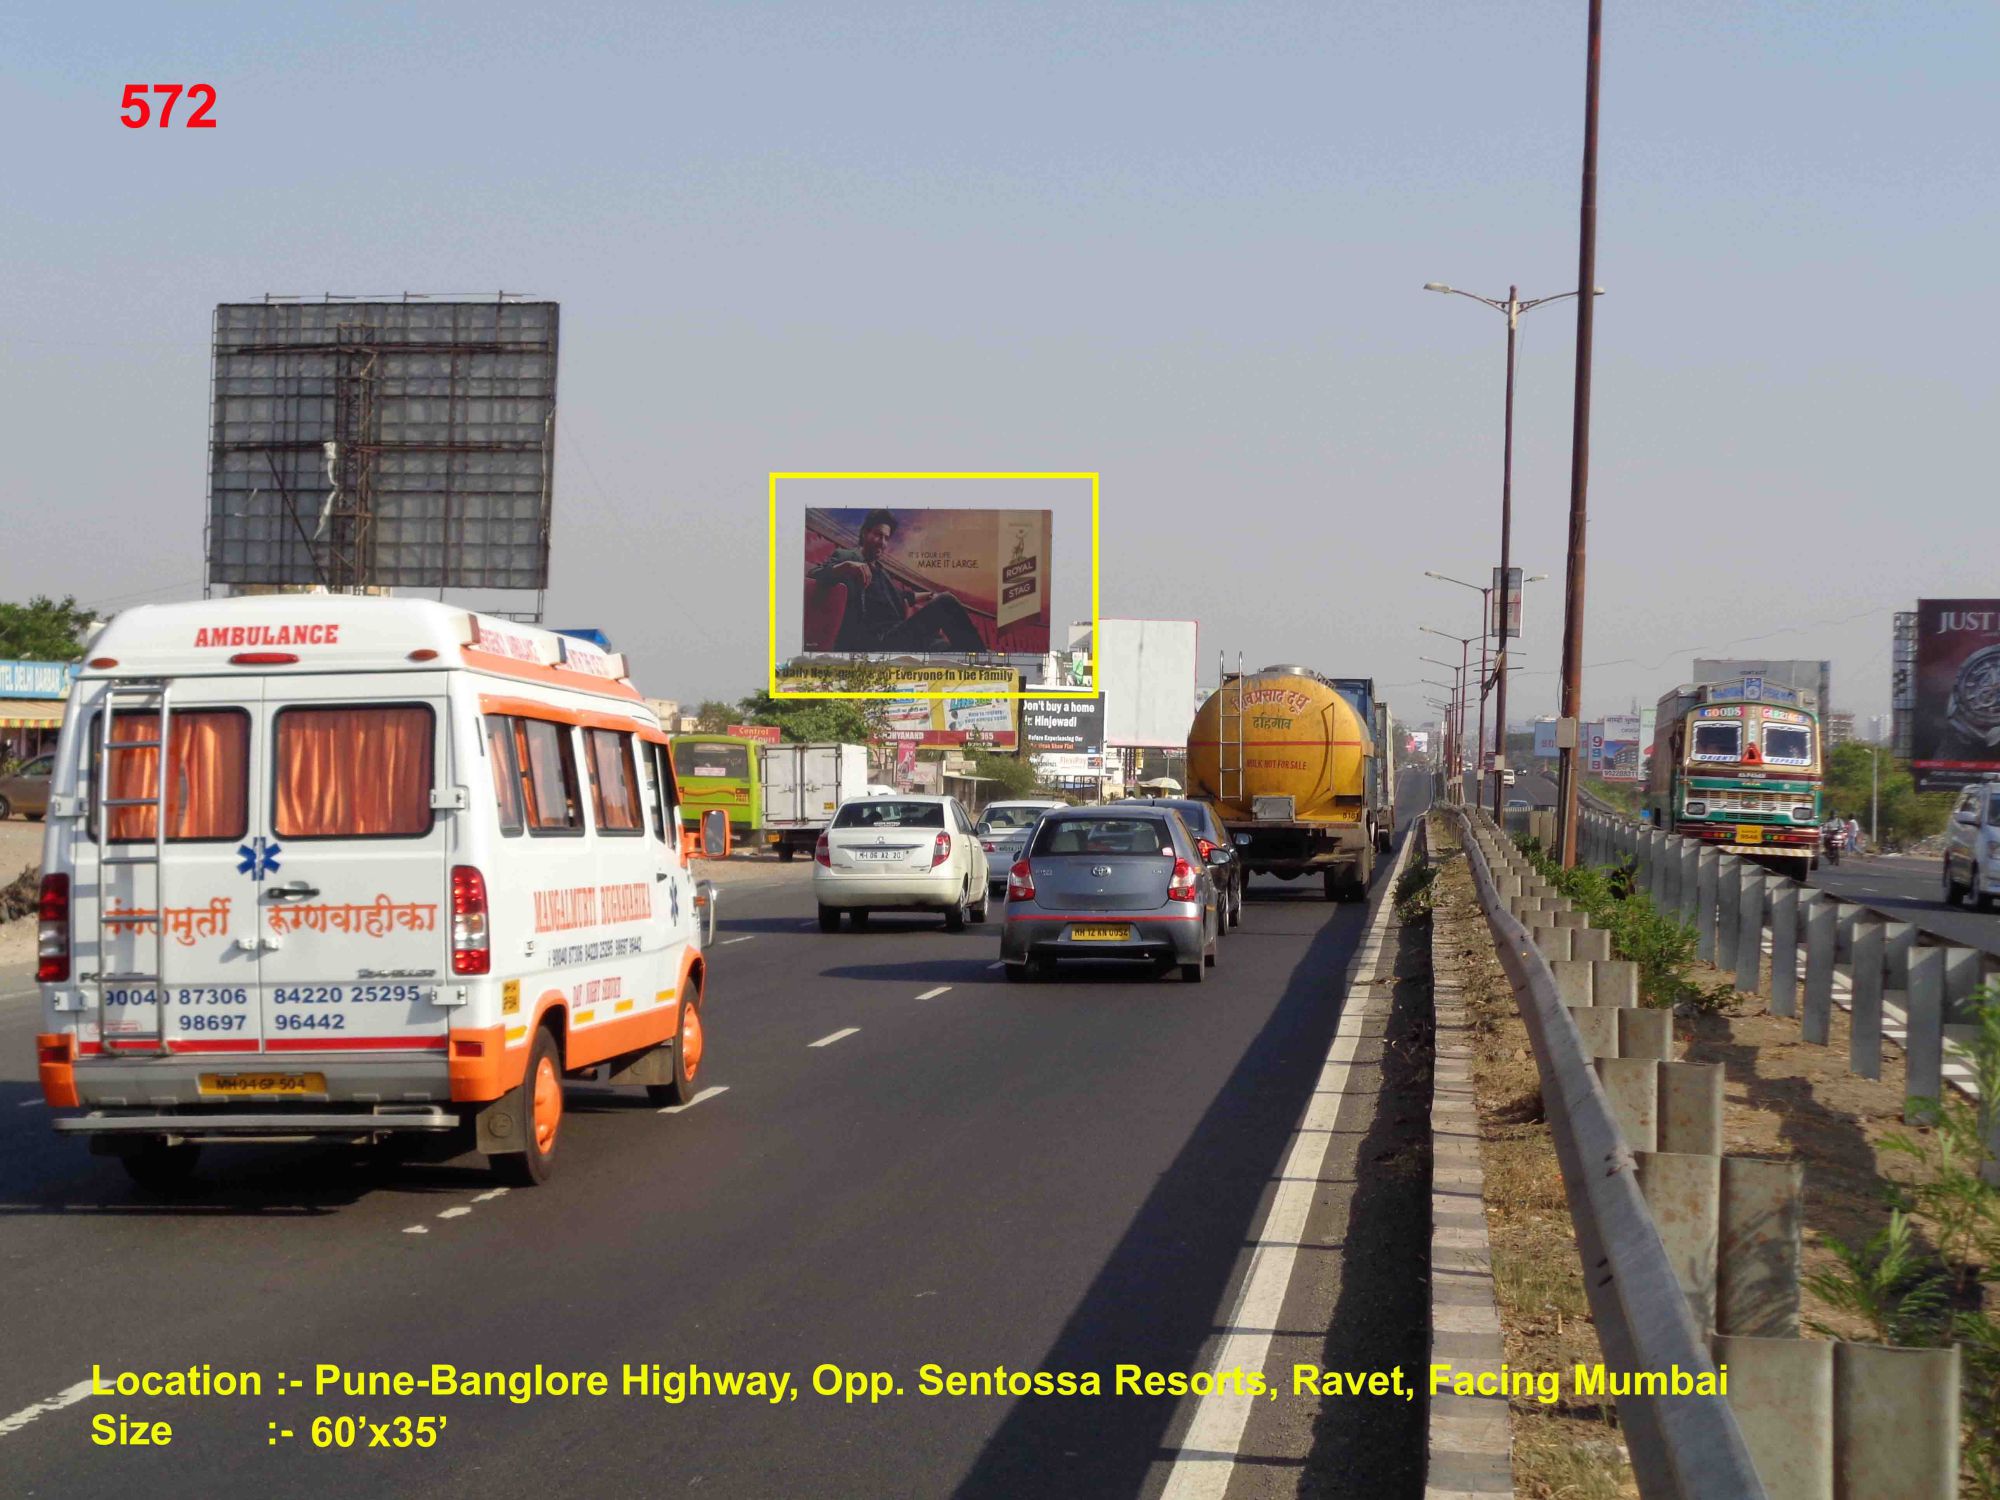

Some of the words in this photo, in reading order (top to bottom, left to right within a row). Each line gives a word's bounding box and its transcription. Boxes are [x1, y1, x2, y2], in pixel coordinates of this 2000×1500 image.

[918, 560, 942, 568] MAKE
[944, 560, 950, 568] IT
[1006, 562, 1033, 578] ROYAL
[1008, 583, 1031, 598] STAG
[1936, 612, 1994, 635] JUST
[194, 624, 339, 647] AMBULANCE
[895, 669, 942, 682] Everyone
[945, 669, 956, 680] In
[958, 669, 980, 681] The
[982, 670, 1013, 682] Family
[1046, 701, 1062, 714] buy
[1063, 703, 1069, 711] a
[1071, 702, 1095, 712] home
[1704, 707, 1741, 718] GOODS
[1290, 761, 1307, 770] SALE
[179, 989, 247, 1005] 87306
[274, 988, 343, 1004] 84220
[351, 986, 420, 1002] 25295
[180, 1015, 246, 1031] 98697
[275, 1014, 345, 1030] 96442
